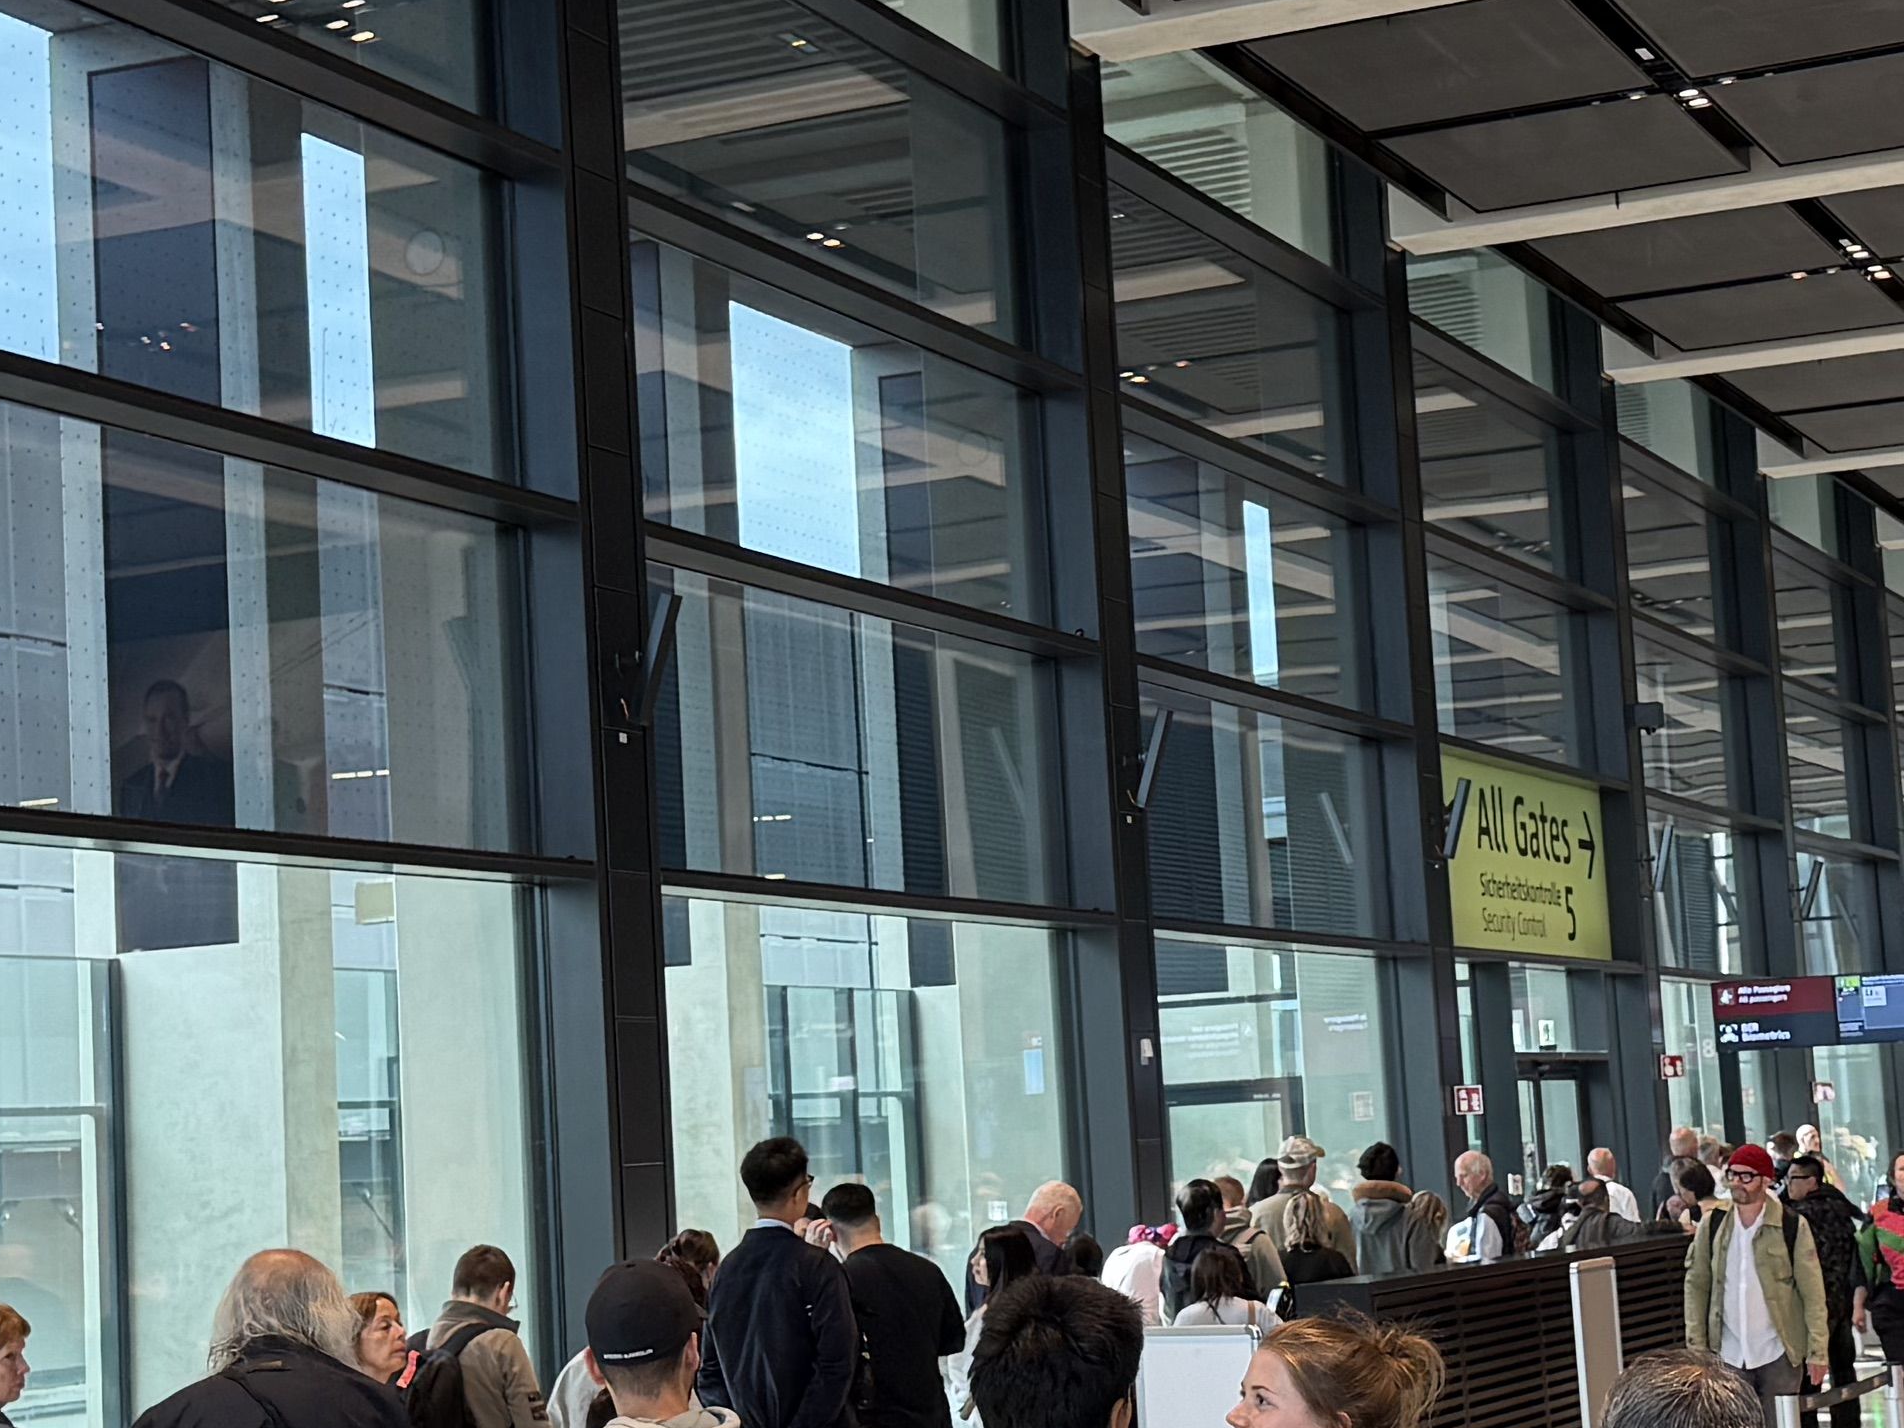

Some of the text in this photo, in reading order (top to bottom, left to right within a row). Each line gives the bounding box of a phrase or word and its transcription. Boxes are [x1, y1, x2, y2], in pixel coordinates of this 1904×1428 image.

[1477, 784, 1572, 865] All Gates
[1482, 907, 1548, 941] Security Control
[1564, 885, 1577, 942] 5
